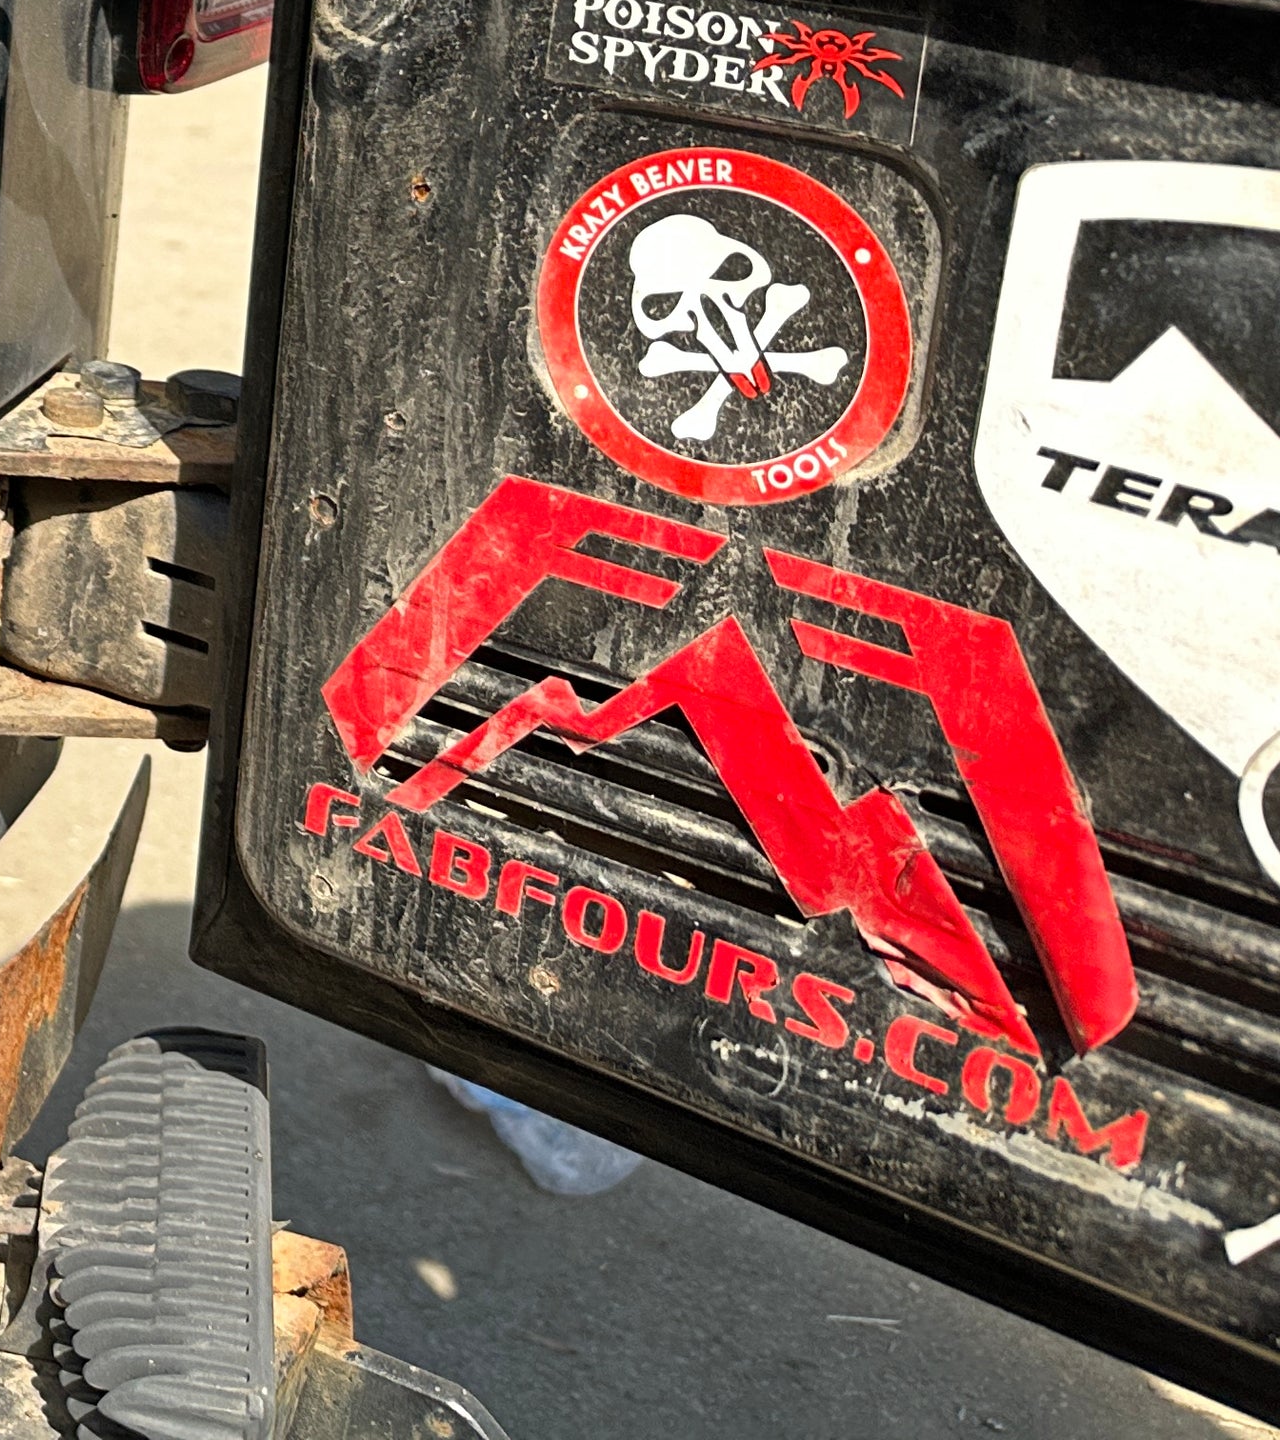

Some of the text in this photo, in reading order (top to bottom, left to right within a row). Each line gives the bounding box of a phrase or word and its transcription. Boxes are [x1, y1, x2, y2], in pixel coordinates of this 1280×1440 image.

[568, 31, 791, 108] SPYDER
[559, 158, 734, 262] KRAZY BEAVER
[751, 437, 849, 494] TOOLS
[303, 781, 1151, 1170] FABFOURS.COM
